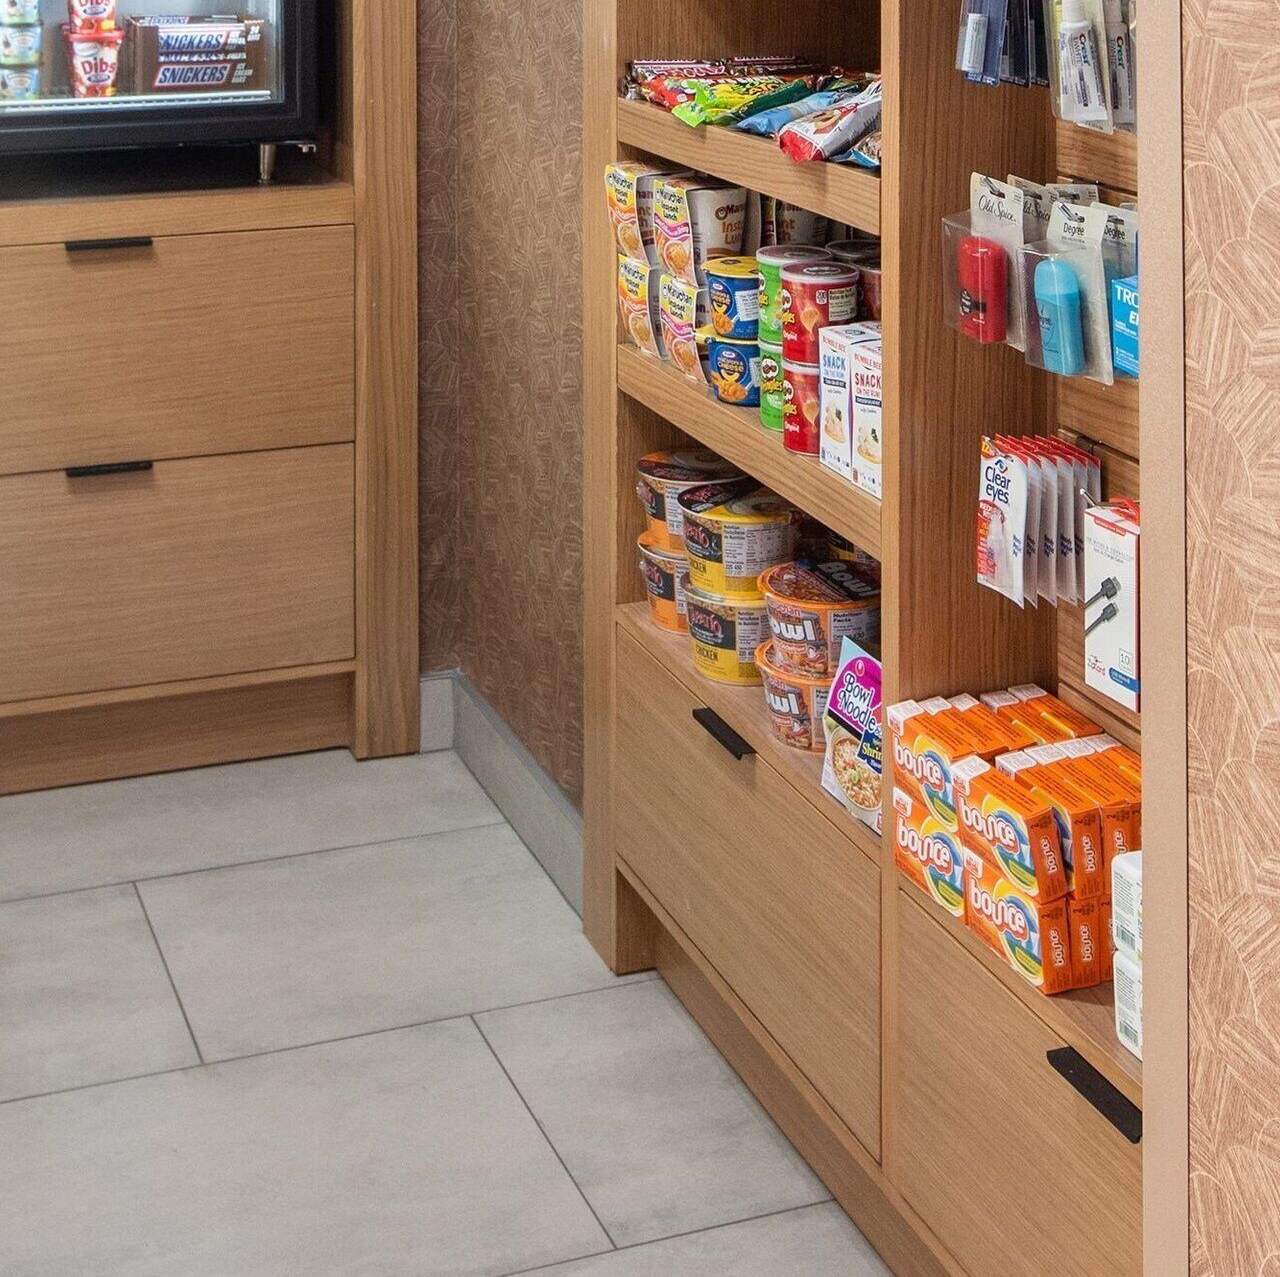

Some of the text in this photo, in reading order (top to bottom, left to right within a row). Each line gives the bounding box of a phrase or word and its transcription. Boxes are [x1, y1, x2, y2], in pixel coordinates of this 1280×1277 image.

[81, 56, 117, 75] Dibs
[159, 66, 228, 83] SNICKERS
[978, 194, 1014, 221] Old Spice
[1063, 223, 1085, 237] Degree
[1104, 224, 1126, 240] Degree
[822, 354, 846, 371] SNACK
[855, 372, 881, 389] SNACK
[985, 465, 1011, 490] Clear
[985, 484, 1010, 505] eyes
[844, 671, 875, 708] Bowl
[838, 689, 877, 733] Noodle
[893, 736, 943, 787] bounce
[959, 795, 1017, 846] bounce
[898, 818, 951, 867] bounce
[1041, 836, 1058, 874] bounce
[1082, 834, 1097, 871] bounce
[970, 880, 1026, 933] bounce
[1050, 927, 1064, 967] bounce
[1080, 924, 1093, 962] bounce
